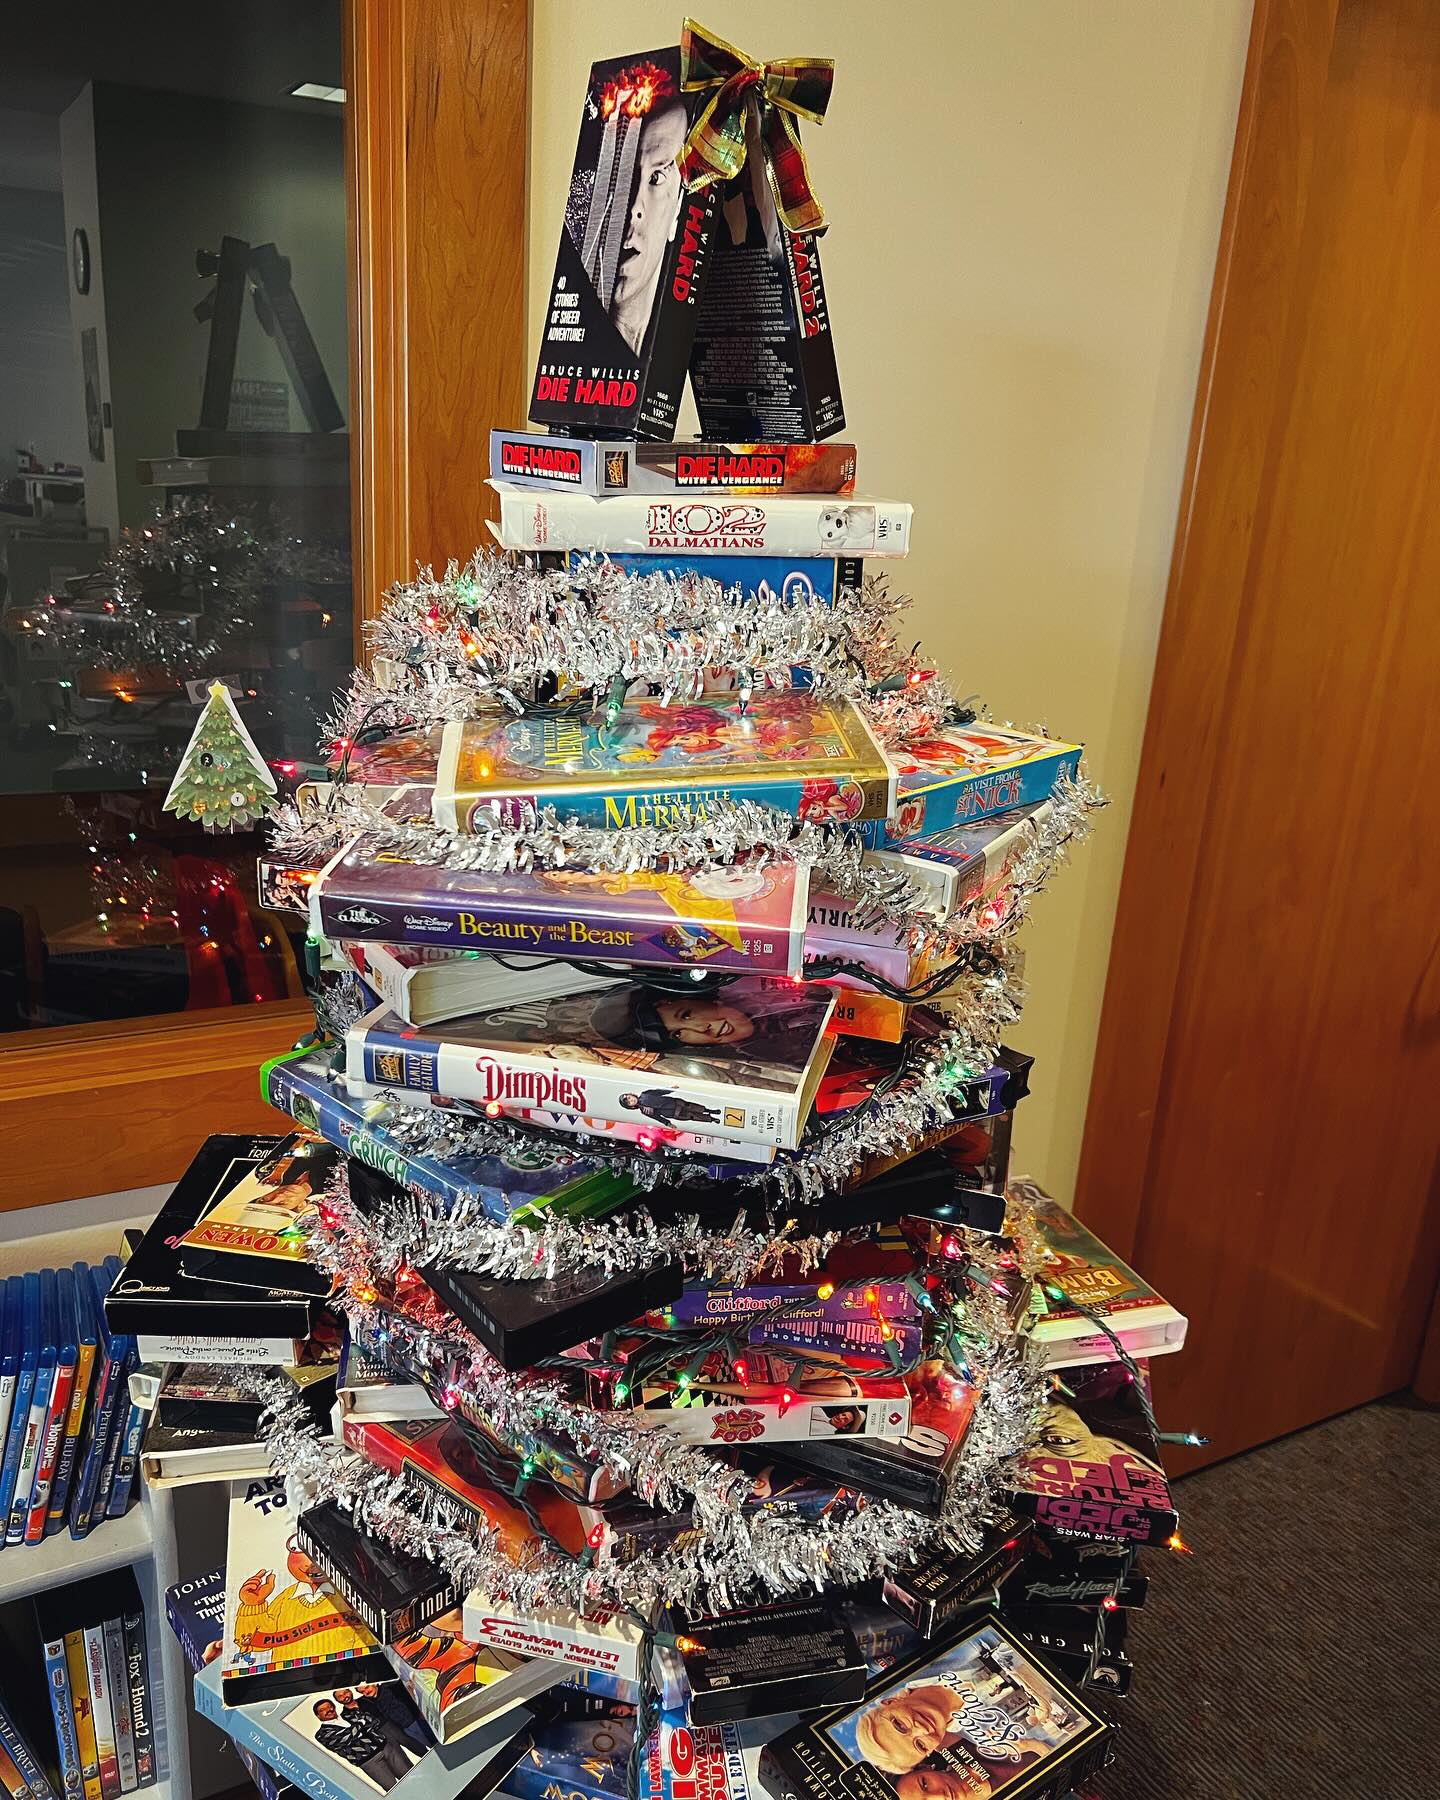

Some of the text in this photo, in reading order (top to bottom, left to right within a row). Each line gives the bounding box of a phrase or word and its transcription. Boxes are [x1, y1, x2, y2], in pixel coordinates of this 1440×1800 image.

[672, 204, 705, 302] HARD
[688, 233, 708, 305] WILLIS
[787, 249, 799, 289] HARDER
[557, 276, 566, 290] 40
[807, 252, 828, 332] WILLIS
[554, 293, 579, 307] STORIES
[551, 311, 580, 325] OF SHEER
[547, 328, 585, 342] ADVENTURE!
[541, 365, 640, 380] BRUCE WILLIS
[536, 376, 637, 407] DIE HARD
[502, 444, 580, 473] DIE HARD
[677, 456, 783, 477] DIE HARD
[503, 464, 580, 481] WITH A VENGEANCE
[678, 476, 782, 485] WITH A VENGEANCE
[649, 504, 767, 536] 102
[878, 517, 888, 539] VHS
[648, 537, 765, 549] DALMATIANS
[974, 777, 994, 790] VISIT
[995, 771, 1015, 785] FROM
[642, 790, 731, 804] THE LITTLE
[971, 778, 1023, 815] NICK
[338, 914, 380, 925] CLASSICS
[458, 912, 566, 945] Beauty and
[549, 921, 634, 946] the Beast
[742, 940, 751, 956] VHS
[409, 1054, 420, 1086] FAMILY
[421, 1053, 434, 1090] FEATURE
[476, 1056, 586, 1113] Dimples
[726, 1112, 743, 1123] 2
[349, 1132, 409, 1187] GRINCH
[198, 1229, 280, 1252] OWEN
[1053, 1270, 1122, 1290] BAM
[707, 1295, 782, 1312] Clifford
[694, 1315, 727, 1326] Happy
[160, 1346, 194, 1356] Prairie
[212, 1347, 244, 1356] House
[246, 1347, 269, 1356] Little
[763, 1332, 829, 1348] SIMMONS
[712, 1408, 765, 1426] FAST
[45, 1423, 63, 1457] HORTON
[95, 1410, 112, 1456] PETER PAN
[710, 1422, 765, 1442] FOOD
[57, 1438, 75, 1480] BLU-RAY
[1023, 1482, 1174, 1511] RETUR
[1036, 1497, 1136, 1528] JEDI
[1055, 1527, 1126, 1542] STAR WARS
[174, 1572, 221, 1599] JOHN
[315, 1545, 378, 1633] INDEPENDENCE
[912, 1562, 943, 1589] MOORE
[926, 1573, 949, 1592] DEMI
[263, 1633, 290, 1645] Plus
[293, 1625, 314, 1638] Sick
[318, 1620, 330, 1628] as
[503, 1628, 620, 1662] LETHAL WEAPON
[489, 1635, 617, 1671] GLOVER DANNY GIBSON MEL
[129, 1654, 149, 1737] Fox Hound 2
[938, 1671, 1010, 1726] Glorie
[952, 1709, 1022, 1763] Grace
[669, 1727, 697, 1800] IG
[722, 1722, 743, 1778] EDITIO
[940, 1747, 970, 1779] ROWLANDS
[955, 1745, 991, 1781] DIANE LANE
[795, 1741, 837, 1788] EDITION
